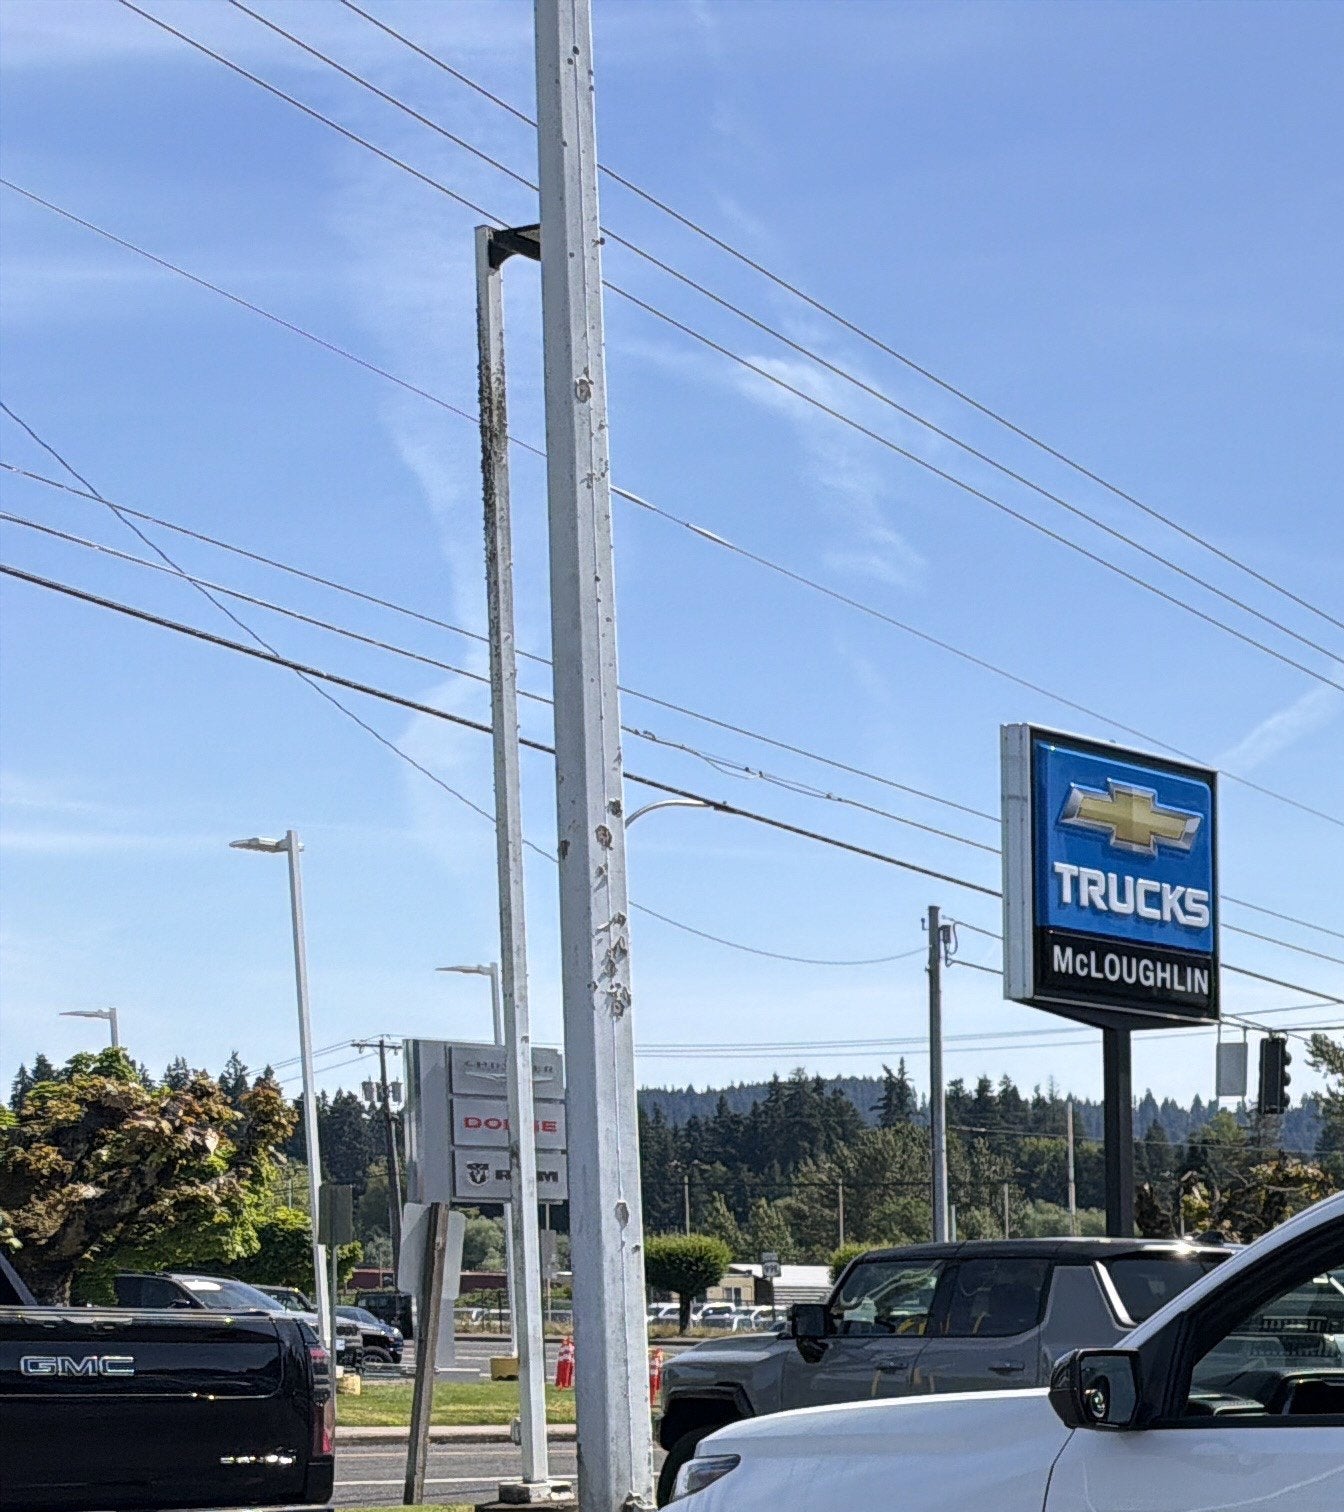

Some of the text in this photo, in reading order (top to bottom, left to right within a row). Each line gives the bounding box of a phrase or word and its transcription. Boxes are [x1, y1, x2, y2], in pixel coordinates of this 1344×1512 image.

[1054, 862, 1210, 928] TRUCKS
[1052, 945, 1209, 995] McLOUGHLIN
[464, 1117, 557, 1132] DOE
[495, 1170, 558, 1182] RM
[20, 1355, 135, 1377] GMC
